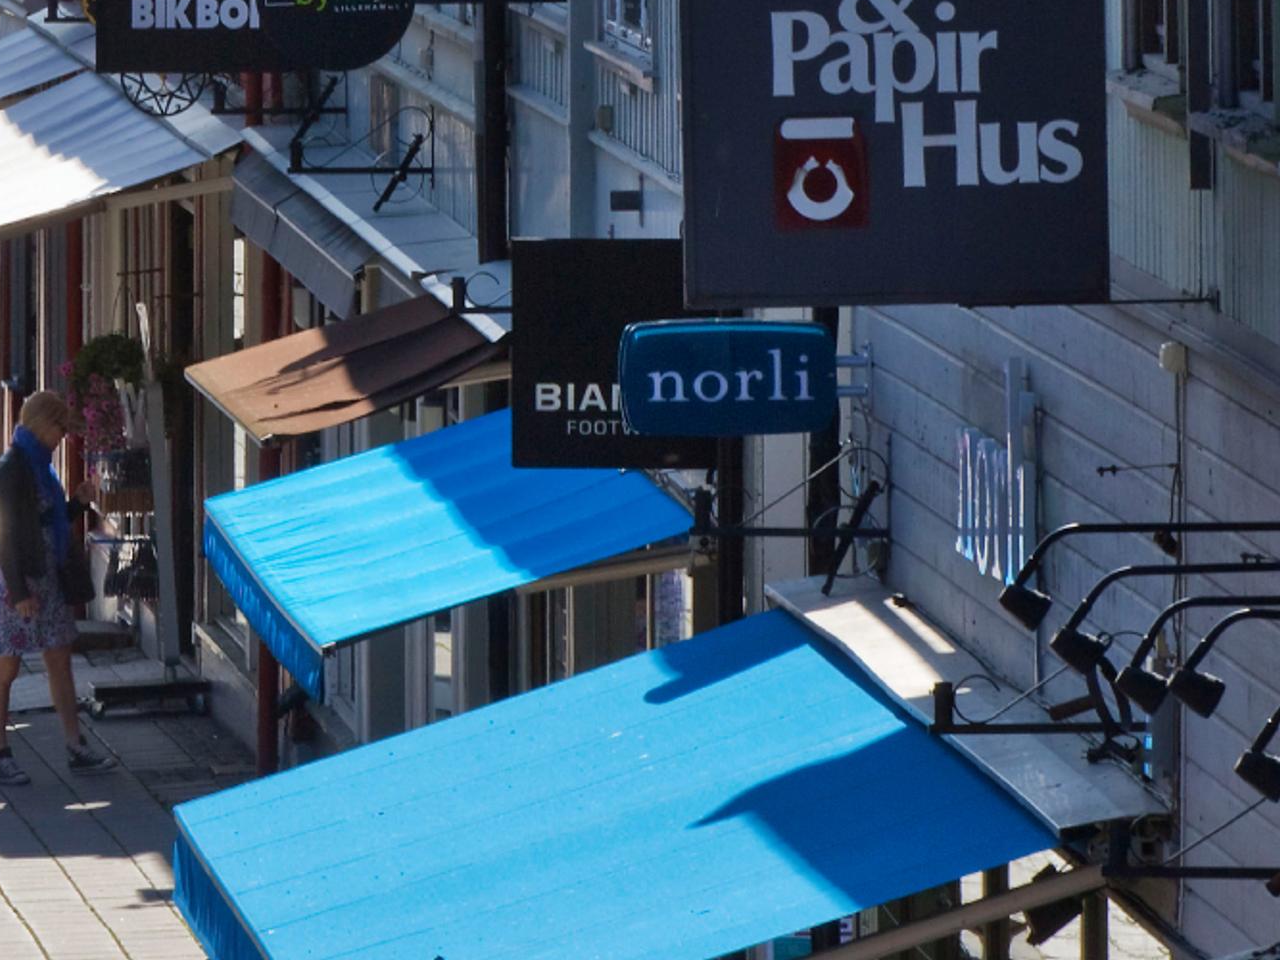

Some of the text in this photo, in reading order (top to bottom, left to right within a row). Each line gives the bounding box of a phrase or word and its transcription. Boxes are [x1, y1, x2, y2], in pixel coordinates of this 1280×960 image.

[771, 1, 998, 123] Papir
[901, 101, 1084, 188] Hus
[647, 349, 815, 404] norli
